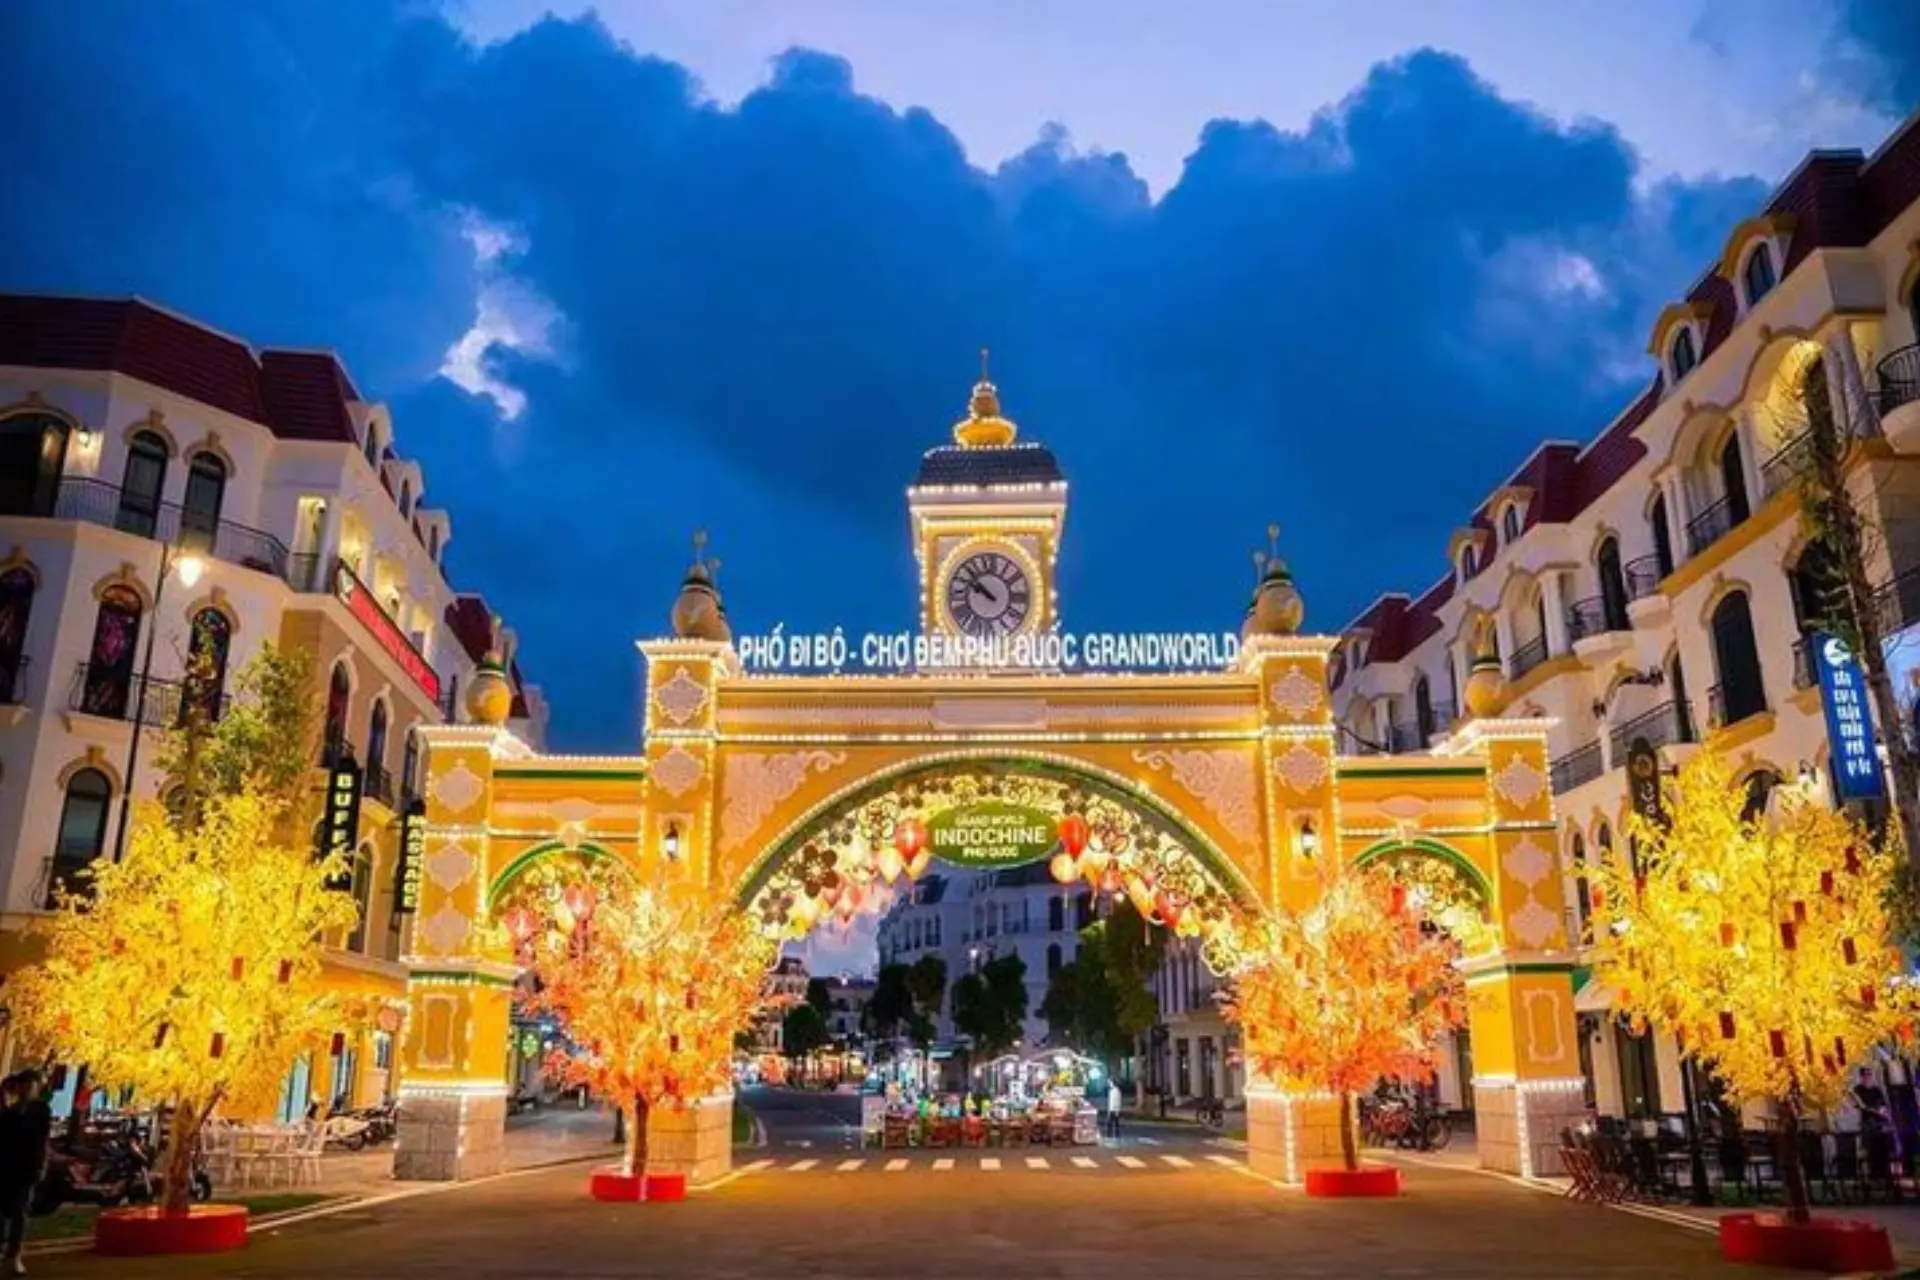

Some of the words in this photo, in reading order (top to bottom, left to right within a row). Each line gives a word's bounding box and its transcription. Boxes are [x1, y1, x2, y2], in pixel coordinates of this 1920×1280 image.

[739, 621, 785, 667] PHỐ
[789, 635, 811, 667] ĐI
[814, 626, 847, 673] BỘ
[1015, 620, 1078, 667] QUỐC
[331, 773, 354, 882] BUFF
[935, 826, 1047, 846] INDOCHINE
